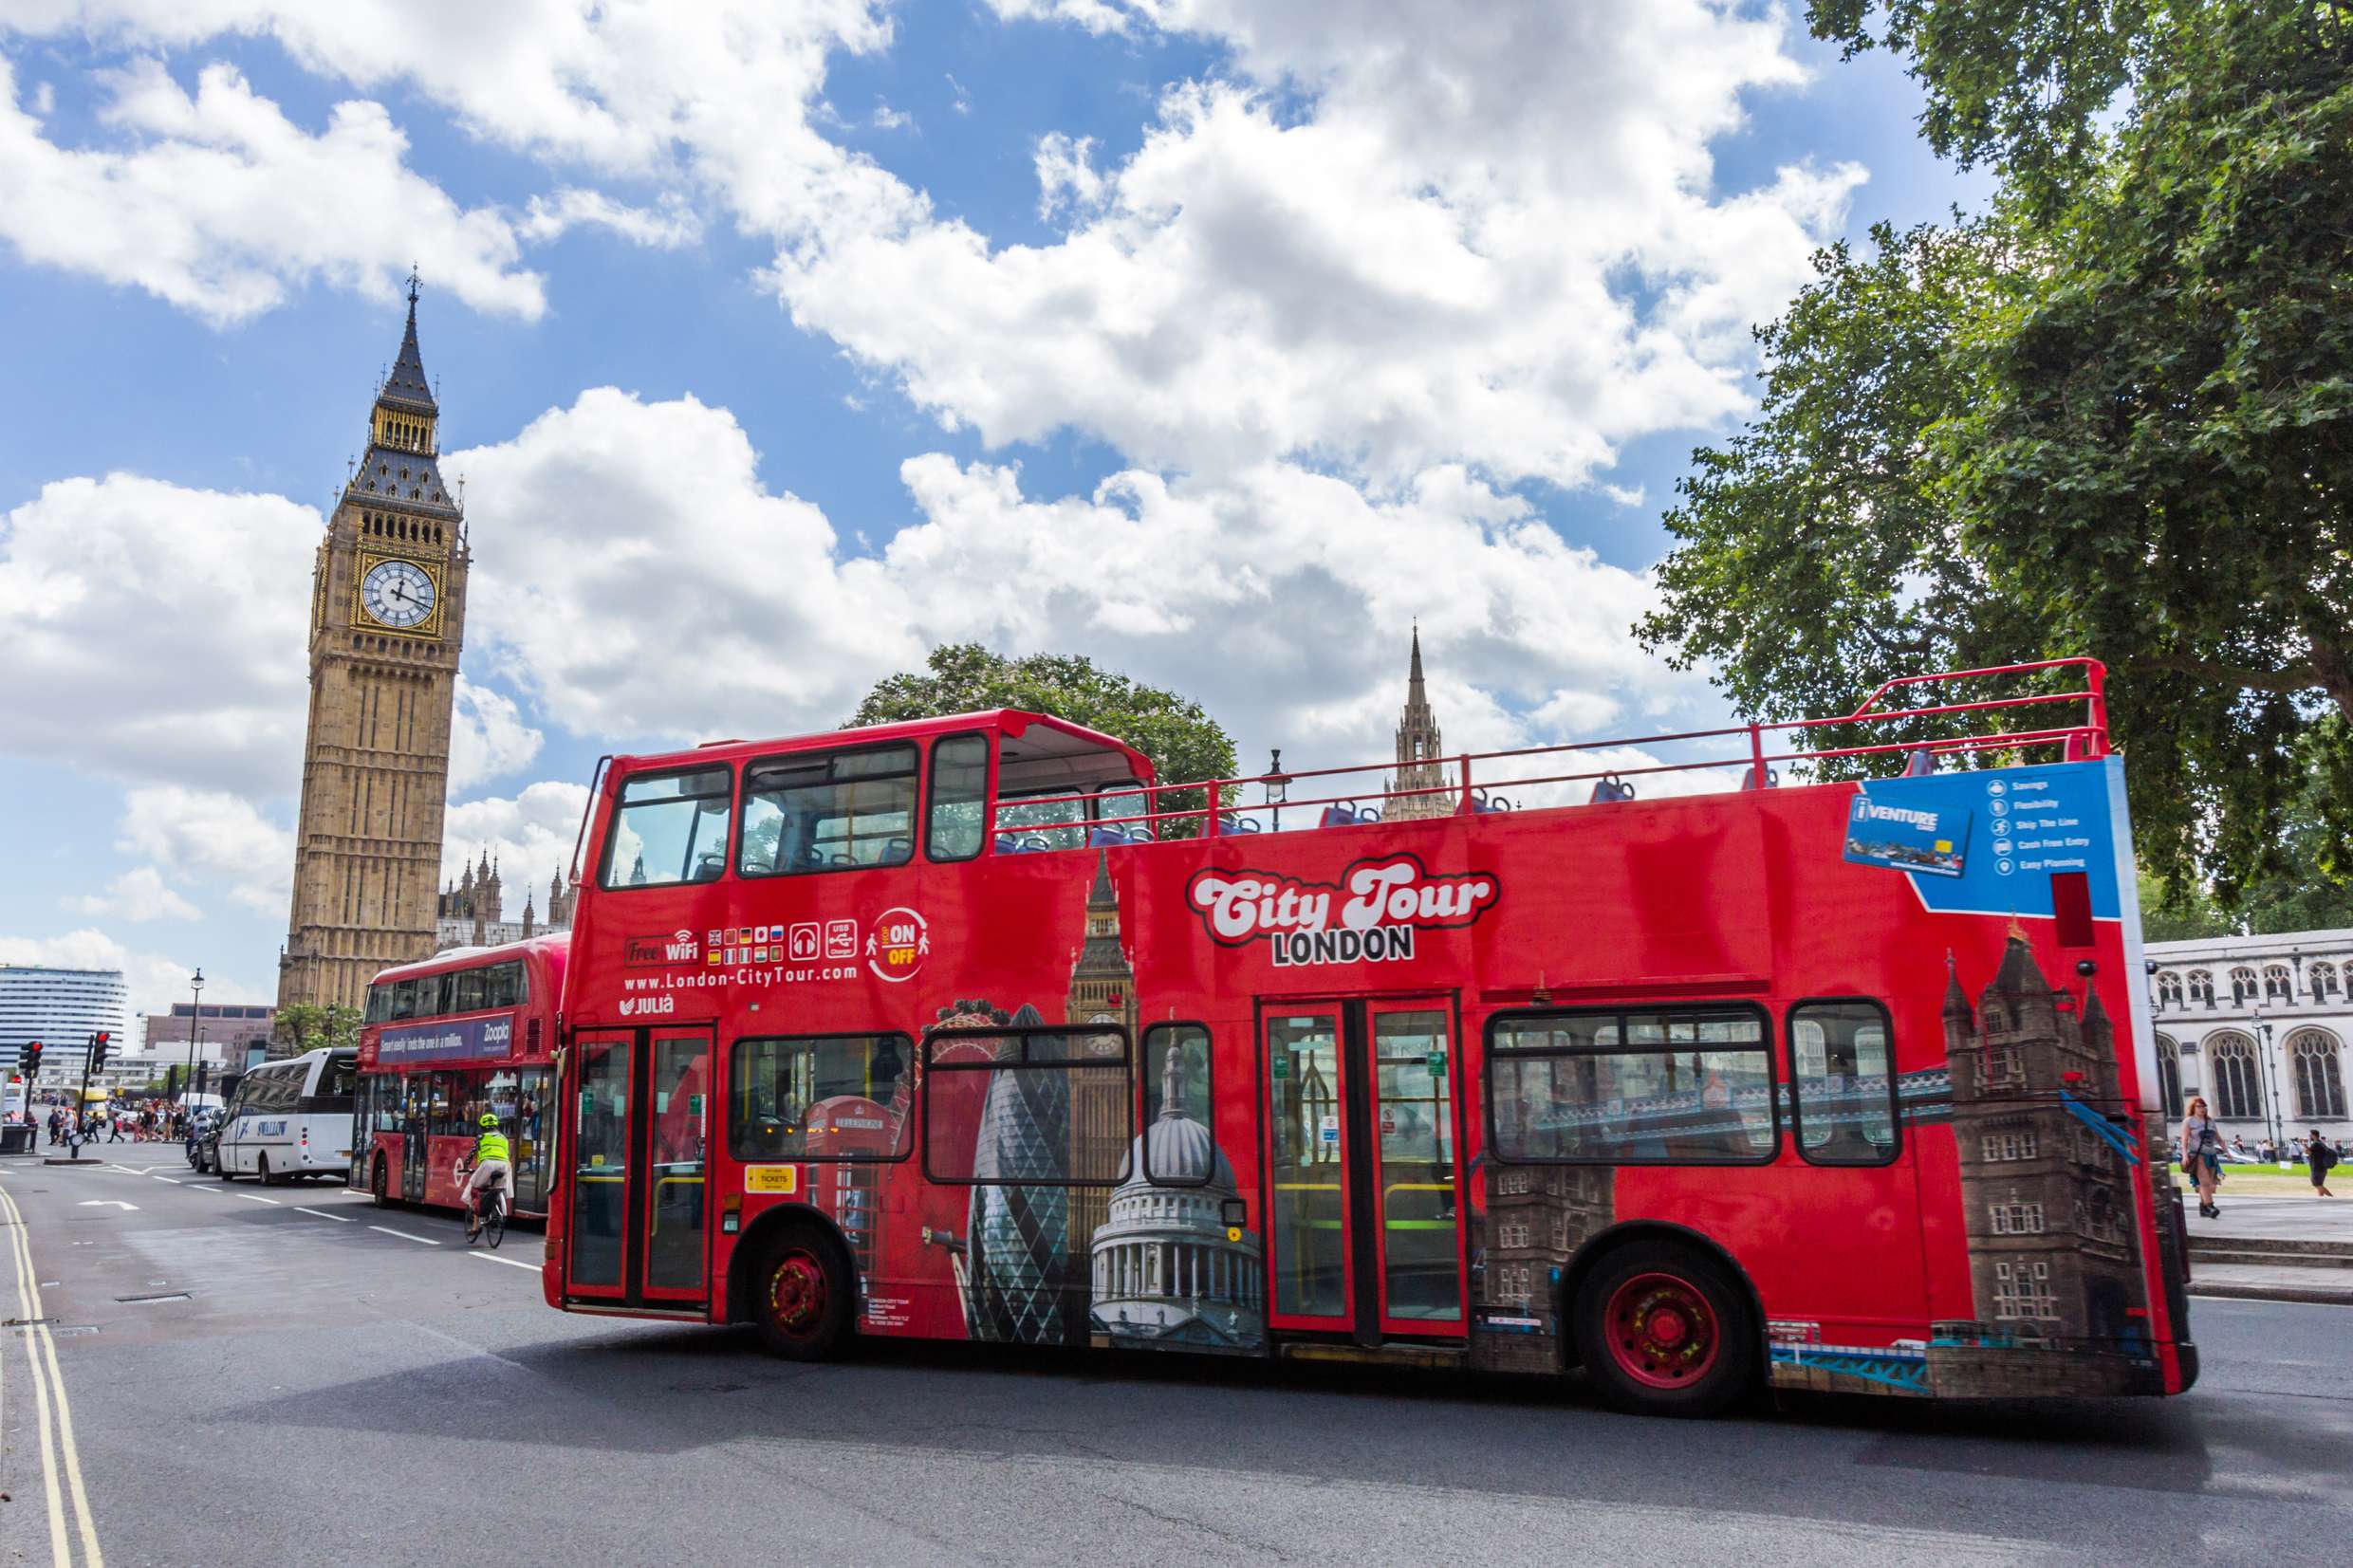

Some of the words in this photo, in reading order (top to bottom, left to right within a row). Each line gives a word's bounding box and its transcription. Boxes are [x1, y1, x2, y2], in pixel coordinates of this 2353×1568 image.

[2016, 821, 2038, 830] Skip
[2038, 819, 2057, 827] The
[2058, 818, 2080, 826] Line
[2018, 840, 2042, 850] Cash
[2065, 838, 2089, 847] Entry
[2020, 860, 2042, 870] Easy
[2043, 858, 2085, 868] Planning
[1195, 876, 1330, 937] City
[1342, 862, 1490, 931] Tour
[833, 924, 850, 933] USB
[890, 924, 915, 944] ON
[629, 940, 658, 962] Free
[666, 940, 698, 961] WiFi
[1272, 924, 1414, 966] LONDON
[888, 949, 916, 966] OFF
[623, 966, 858, 991] www.London-CityTour.com
[484, 1022, 510, 1044] Zoopla
[761, 1175, 787, 1184] TICKETS
